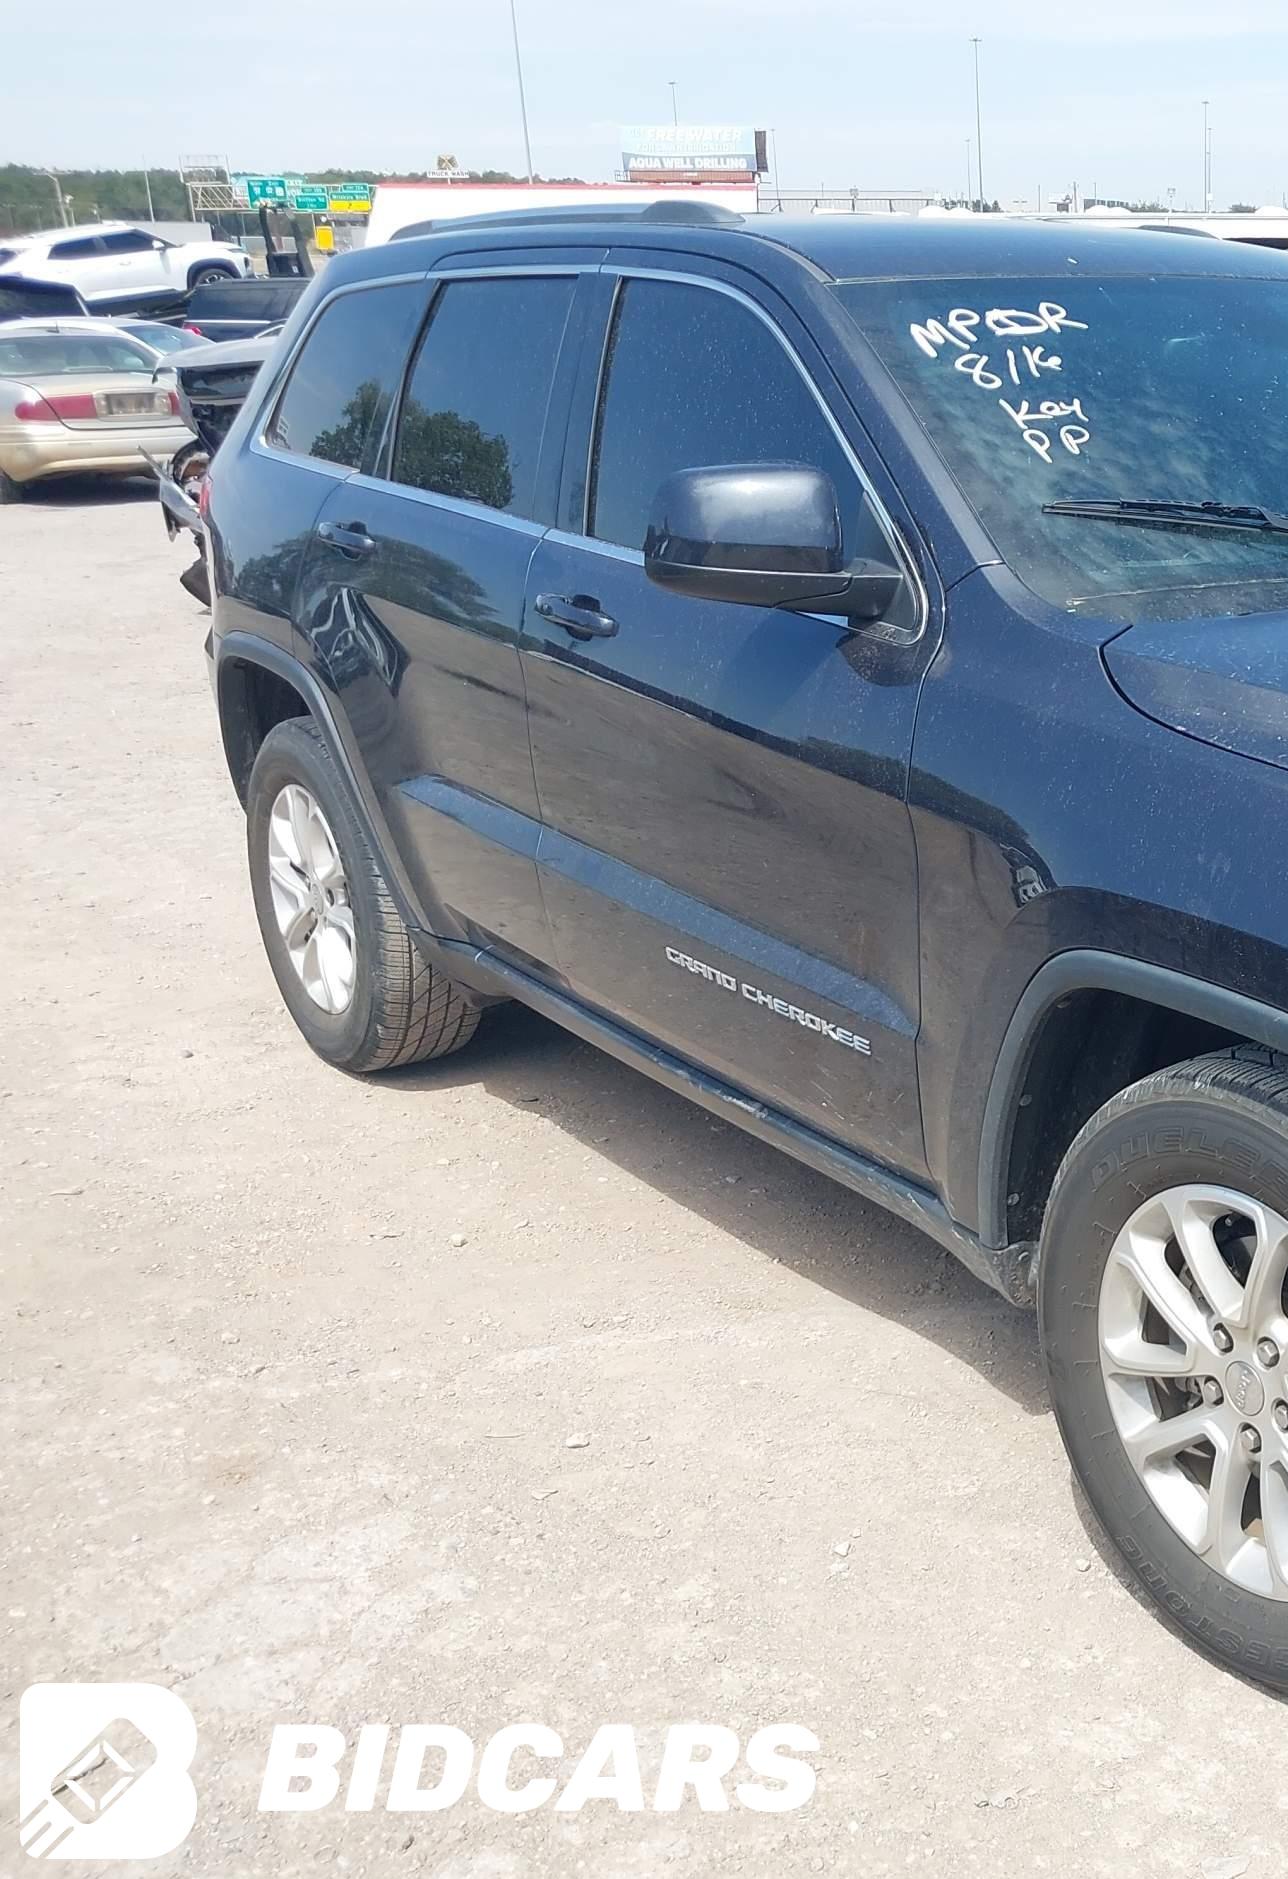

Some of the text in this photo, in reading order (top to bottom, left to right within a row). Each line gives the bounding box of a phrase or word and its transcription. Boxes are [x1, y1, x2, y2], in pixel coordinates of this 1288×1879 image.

[629, 157, 747, 169] AQUA WELL DRILLING
[665, 946, 872, 1056] GRAND CHEROKEE
